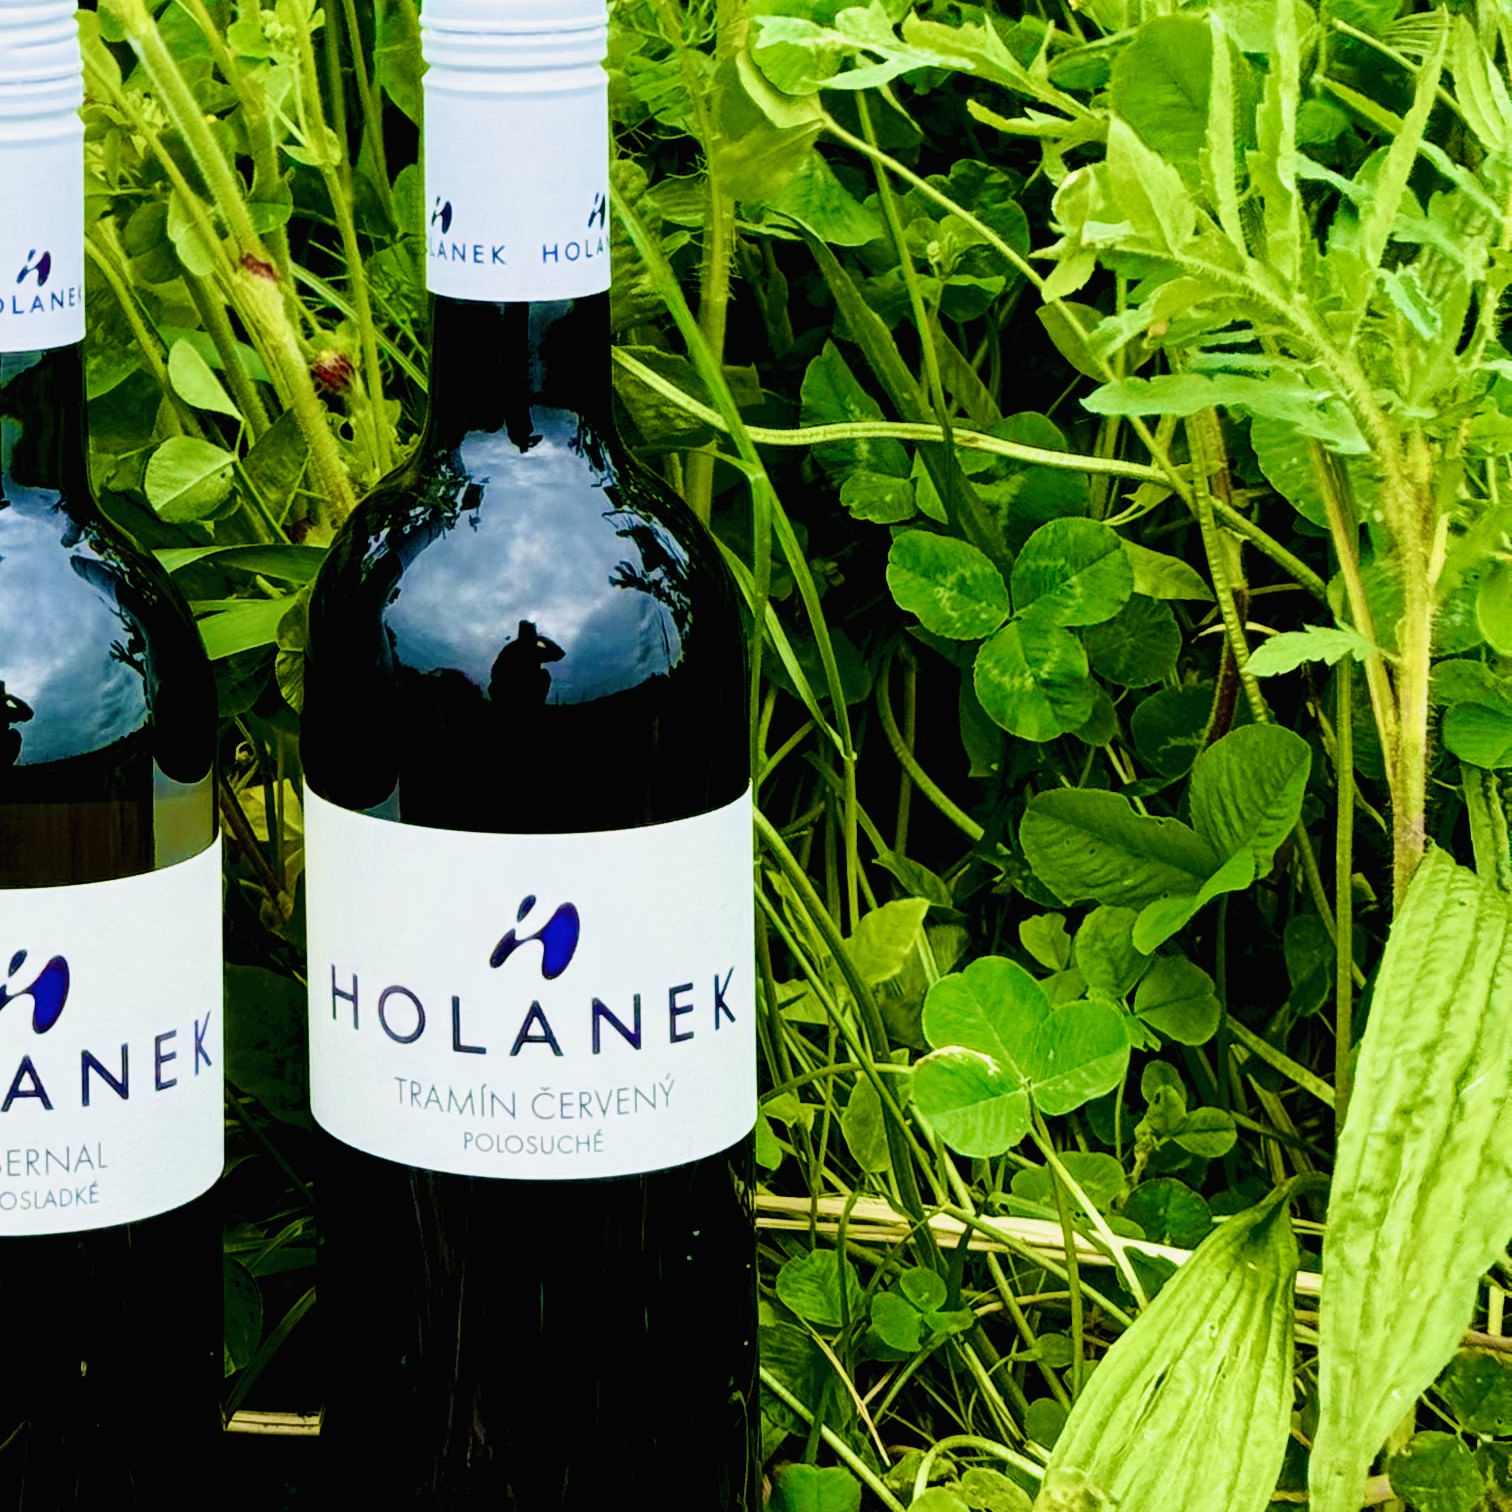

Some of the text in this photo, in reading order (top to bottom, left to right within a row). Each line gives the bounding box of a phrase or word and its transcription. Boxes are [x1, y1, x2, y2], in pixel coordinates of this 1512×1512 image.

[330, 963, 737, 1057] HOLANEK
[394, 1073, 676, 1120] TRAMÍN ČERVENÝ
[463, 1129, 605, 1155] POLOSUCHÉ
